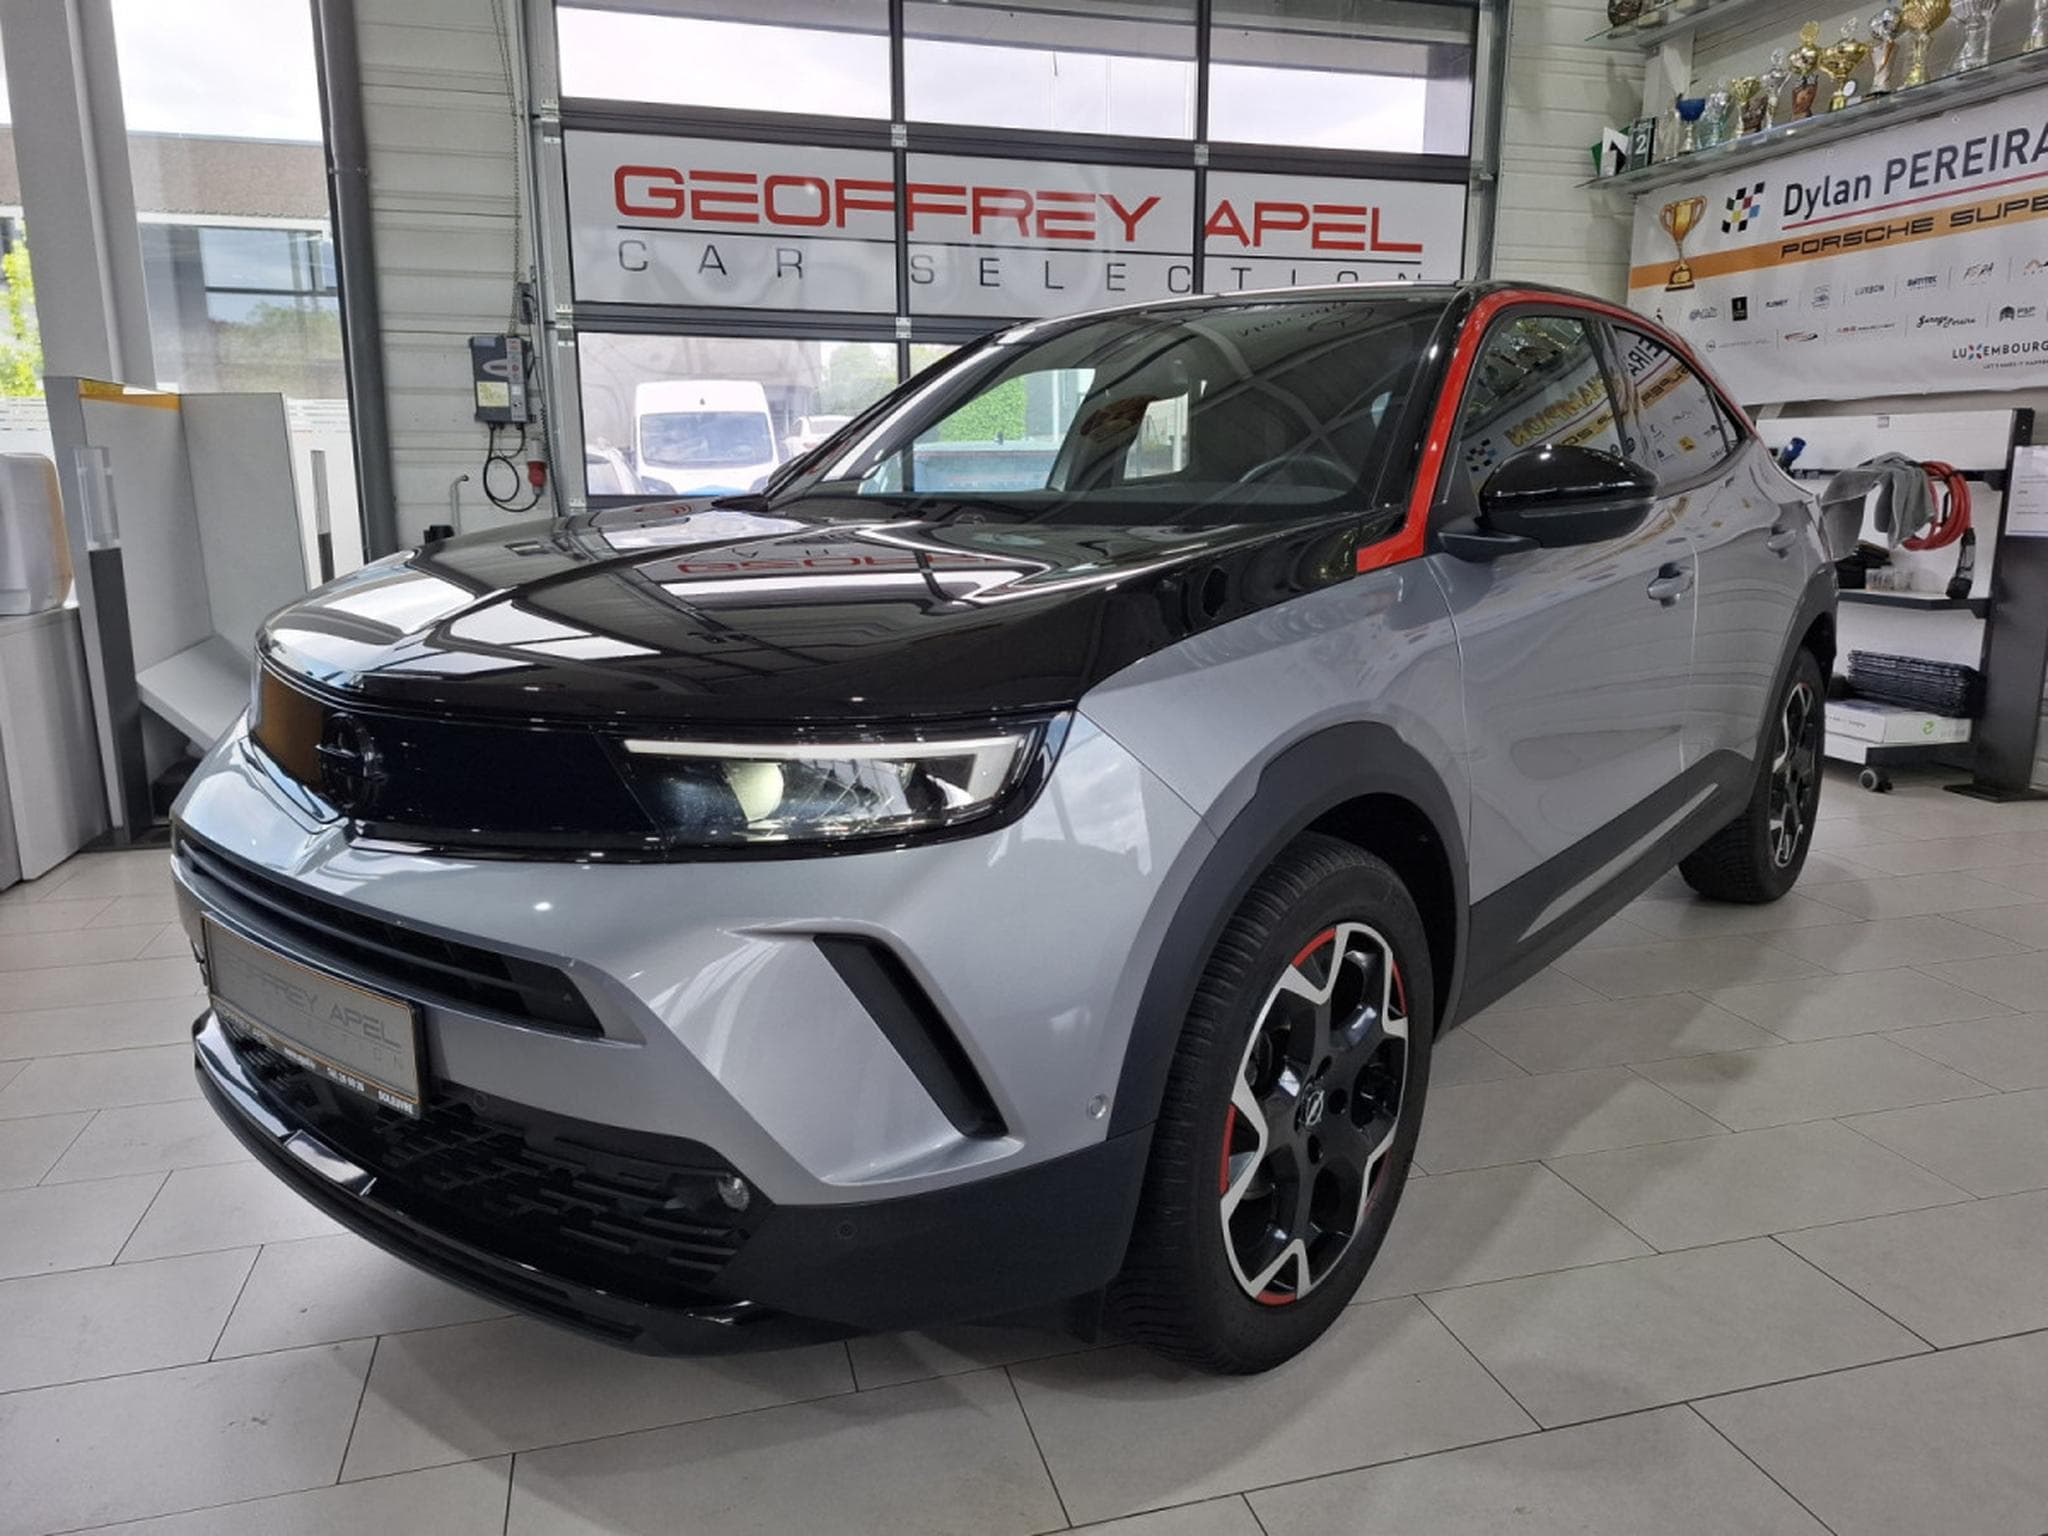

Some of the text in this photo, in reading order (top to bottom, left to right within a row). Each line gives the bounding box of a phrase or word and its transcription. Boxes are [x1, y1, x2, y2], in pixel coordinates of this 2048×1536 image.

[1783, 122, 2048, 220] Dylan PEREIRA
[614, 165, 1424, 254] GEOFFREY APEL
[1781, 216, 1934, 259] PORSCHE
[618, 240, 1421, 294] CAR SELECTI
[1952, 340, 2048, 361] LUXEMBOURG
